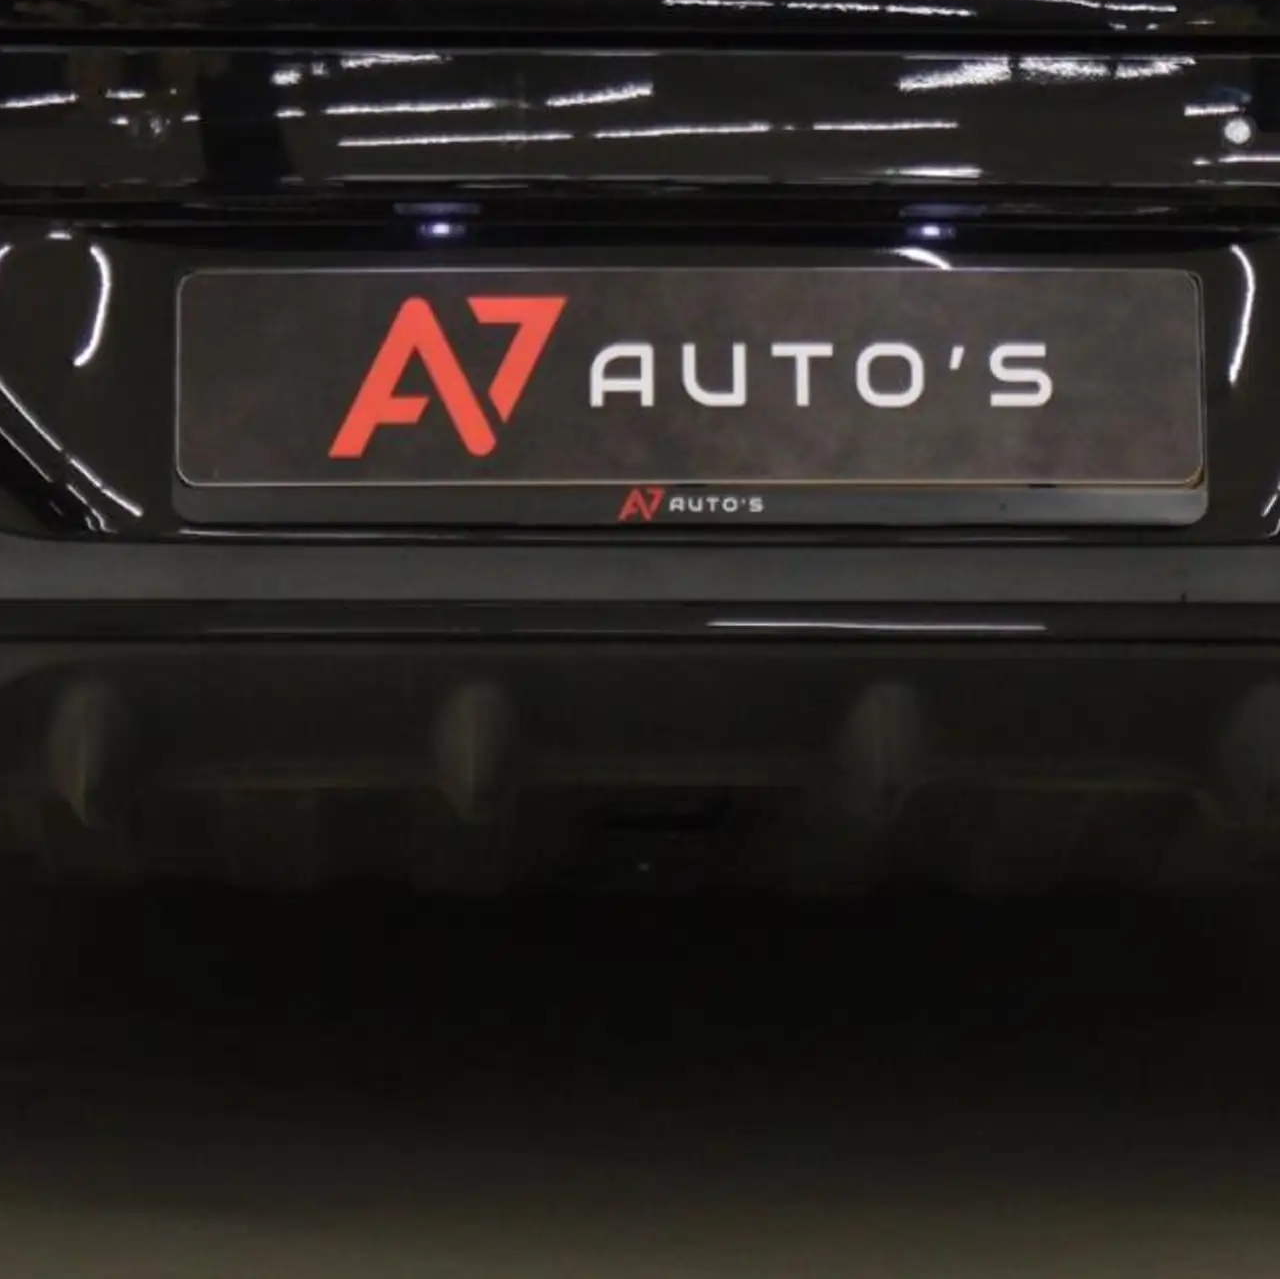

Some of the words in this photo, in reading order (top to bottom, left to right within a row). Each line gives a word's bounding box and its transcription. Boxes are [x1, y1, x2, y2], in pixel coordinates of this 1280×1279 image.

[328, 294, 568, 458] A7
[589, 341, 1053, 407] AUTO'S
[618, 487, 664, 520] A7
[669, 496, 764, 512] AUTO'S
